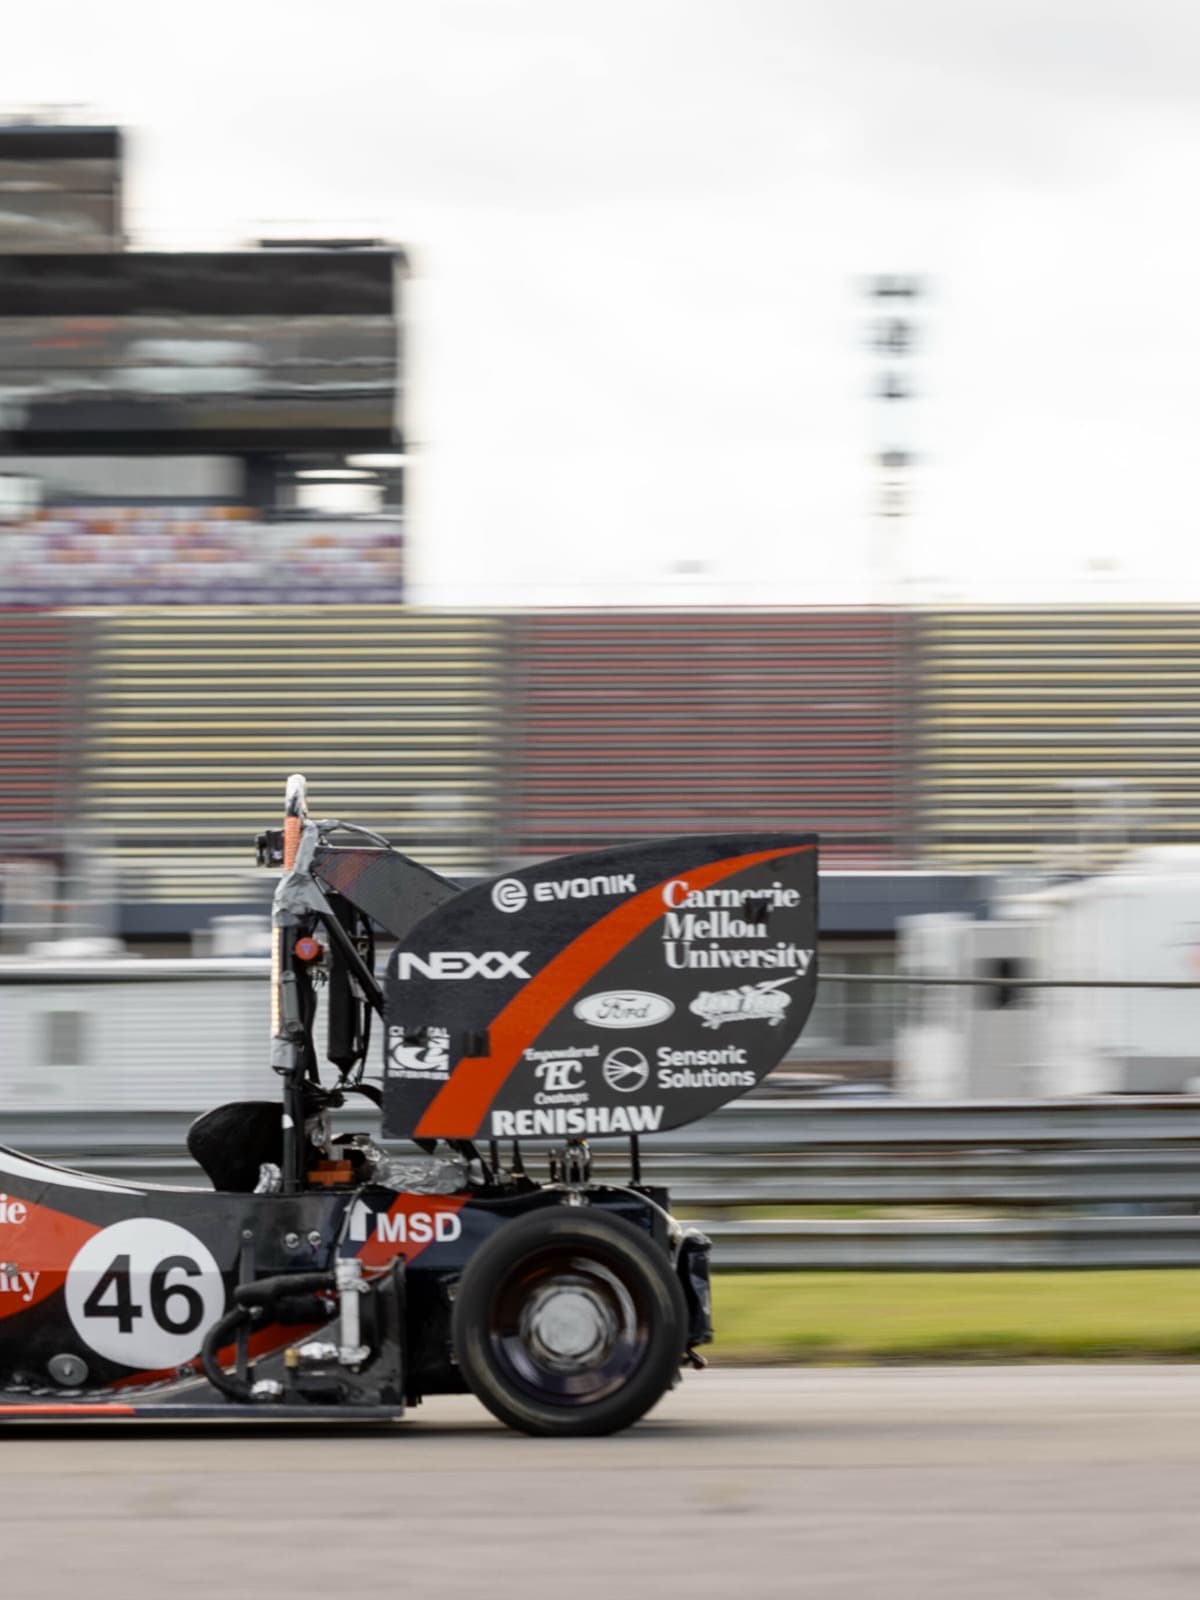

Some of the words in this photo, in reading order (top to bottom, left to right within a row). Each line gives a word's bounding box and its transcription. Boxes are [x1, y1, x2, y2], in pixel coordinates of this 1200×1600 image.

[533, 873, 637, 902] EVONIK
[398, 951, 532, 980] NEXX
[662, 942, 814, 975] University
[596, 997, 651, 1019] Ford
[657, 1045, 747, 1066] Sensoric
[657, 1067, 755, 1089] Solutions
[492, 1105, 664, 1136] RENISHAW
[377, 1212, 461, 1243] MSD
[83, 1254, 205, 1336] 46
